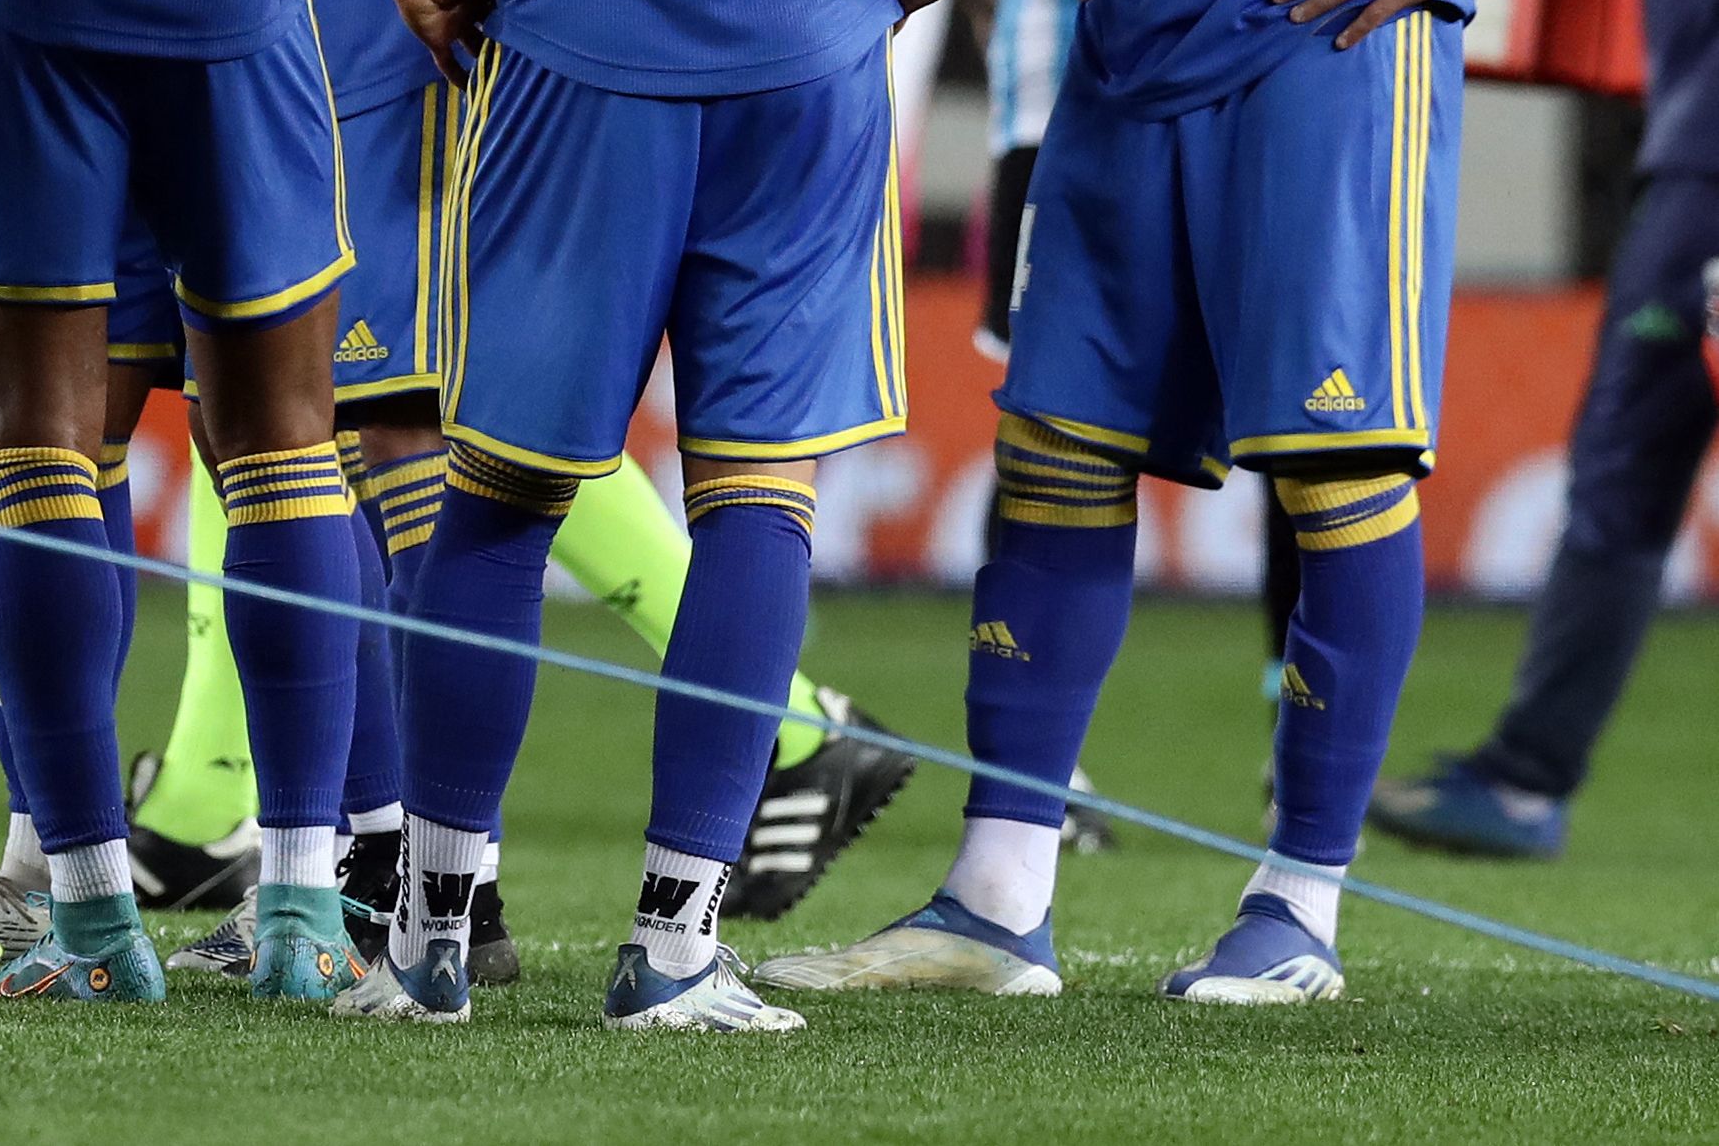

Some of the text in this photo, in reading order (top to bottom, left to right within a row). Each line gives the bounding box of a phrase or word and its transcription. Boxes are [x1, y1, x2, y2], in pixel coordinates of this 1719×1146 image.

[333, 345, 389, 362] adidas
[1304, 395, 1365, 412] adidas
[634, 916, 687, 935] ONDER
